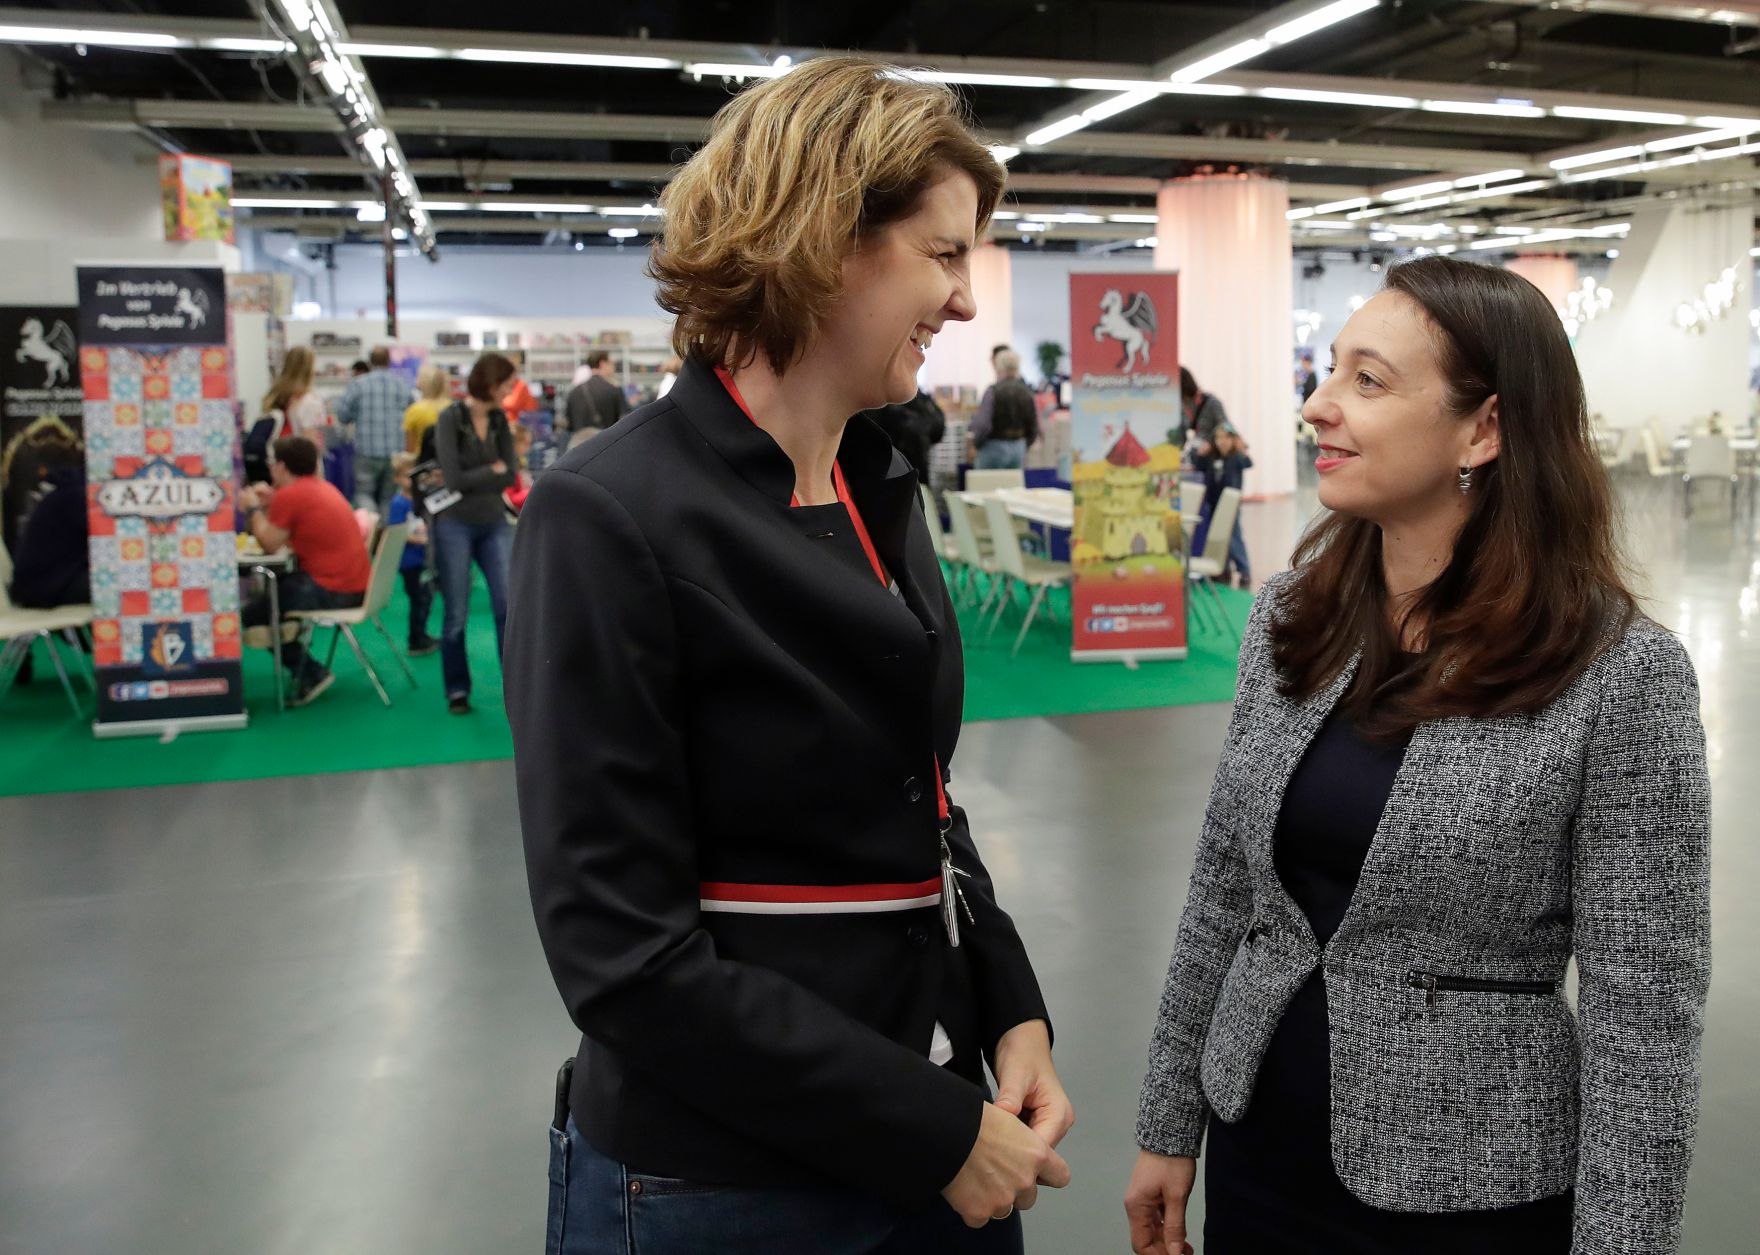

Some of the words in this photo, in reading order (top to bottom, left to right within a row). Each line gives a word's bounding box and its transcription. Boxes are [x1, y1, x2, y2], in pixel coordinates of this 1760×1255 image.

[119, 280, 178, 297] Vertrieb
[126, 299, 151, 312] von
[98, 313, 147, 331] Pegasus
[147, 313, 185, 331] Spiele
[1082, 373, 1130, 388] Pegasus
[1132, 373, 1169, 388] Spiele
[120, 484, 202, 505] AZUL
